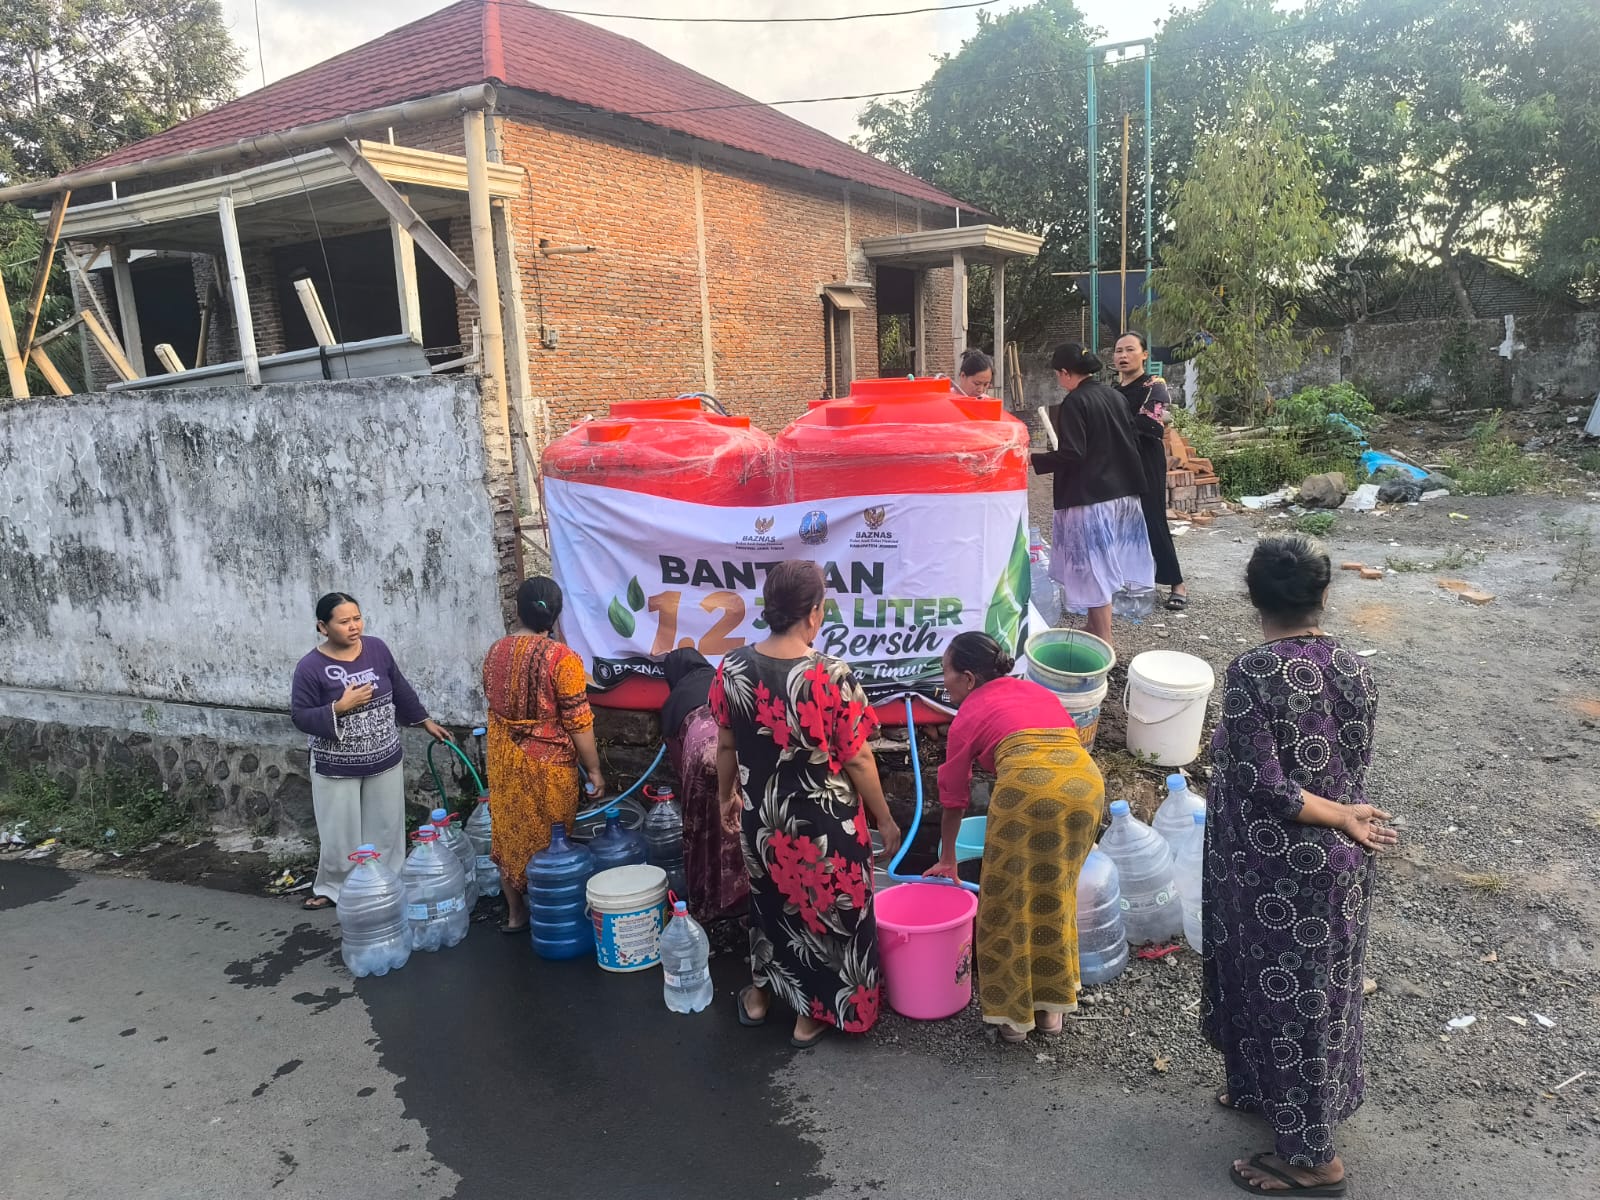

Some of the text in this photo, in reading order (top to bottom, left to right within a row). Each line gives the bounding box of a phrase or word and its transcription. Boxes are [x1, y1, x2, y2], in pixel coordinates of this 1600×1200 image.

[742, 535, 776, 543] BAZNAS
[855, 531, 893, 539] BAZNAS
[659, 555, 884, 594] BANTAN
[853, 597, 964, 628] LITER
[821, 621, 943, 657] Bersih
[872, 663, 927, 681] Timur
